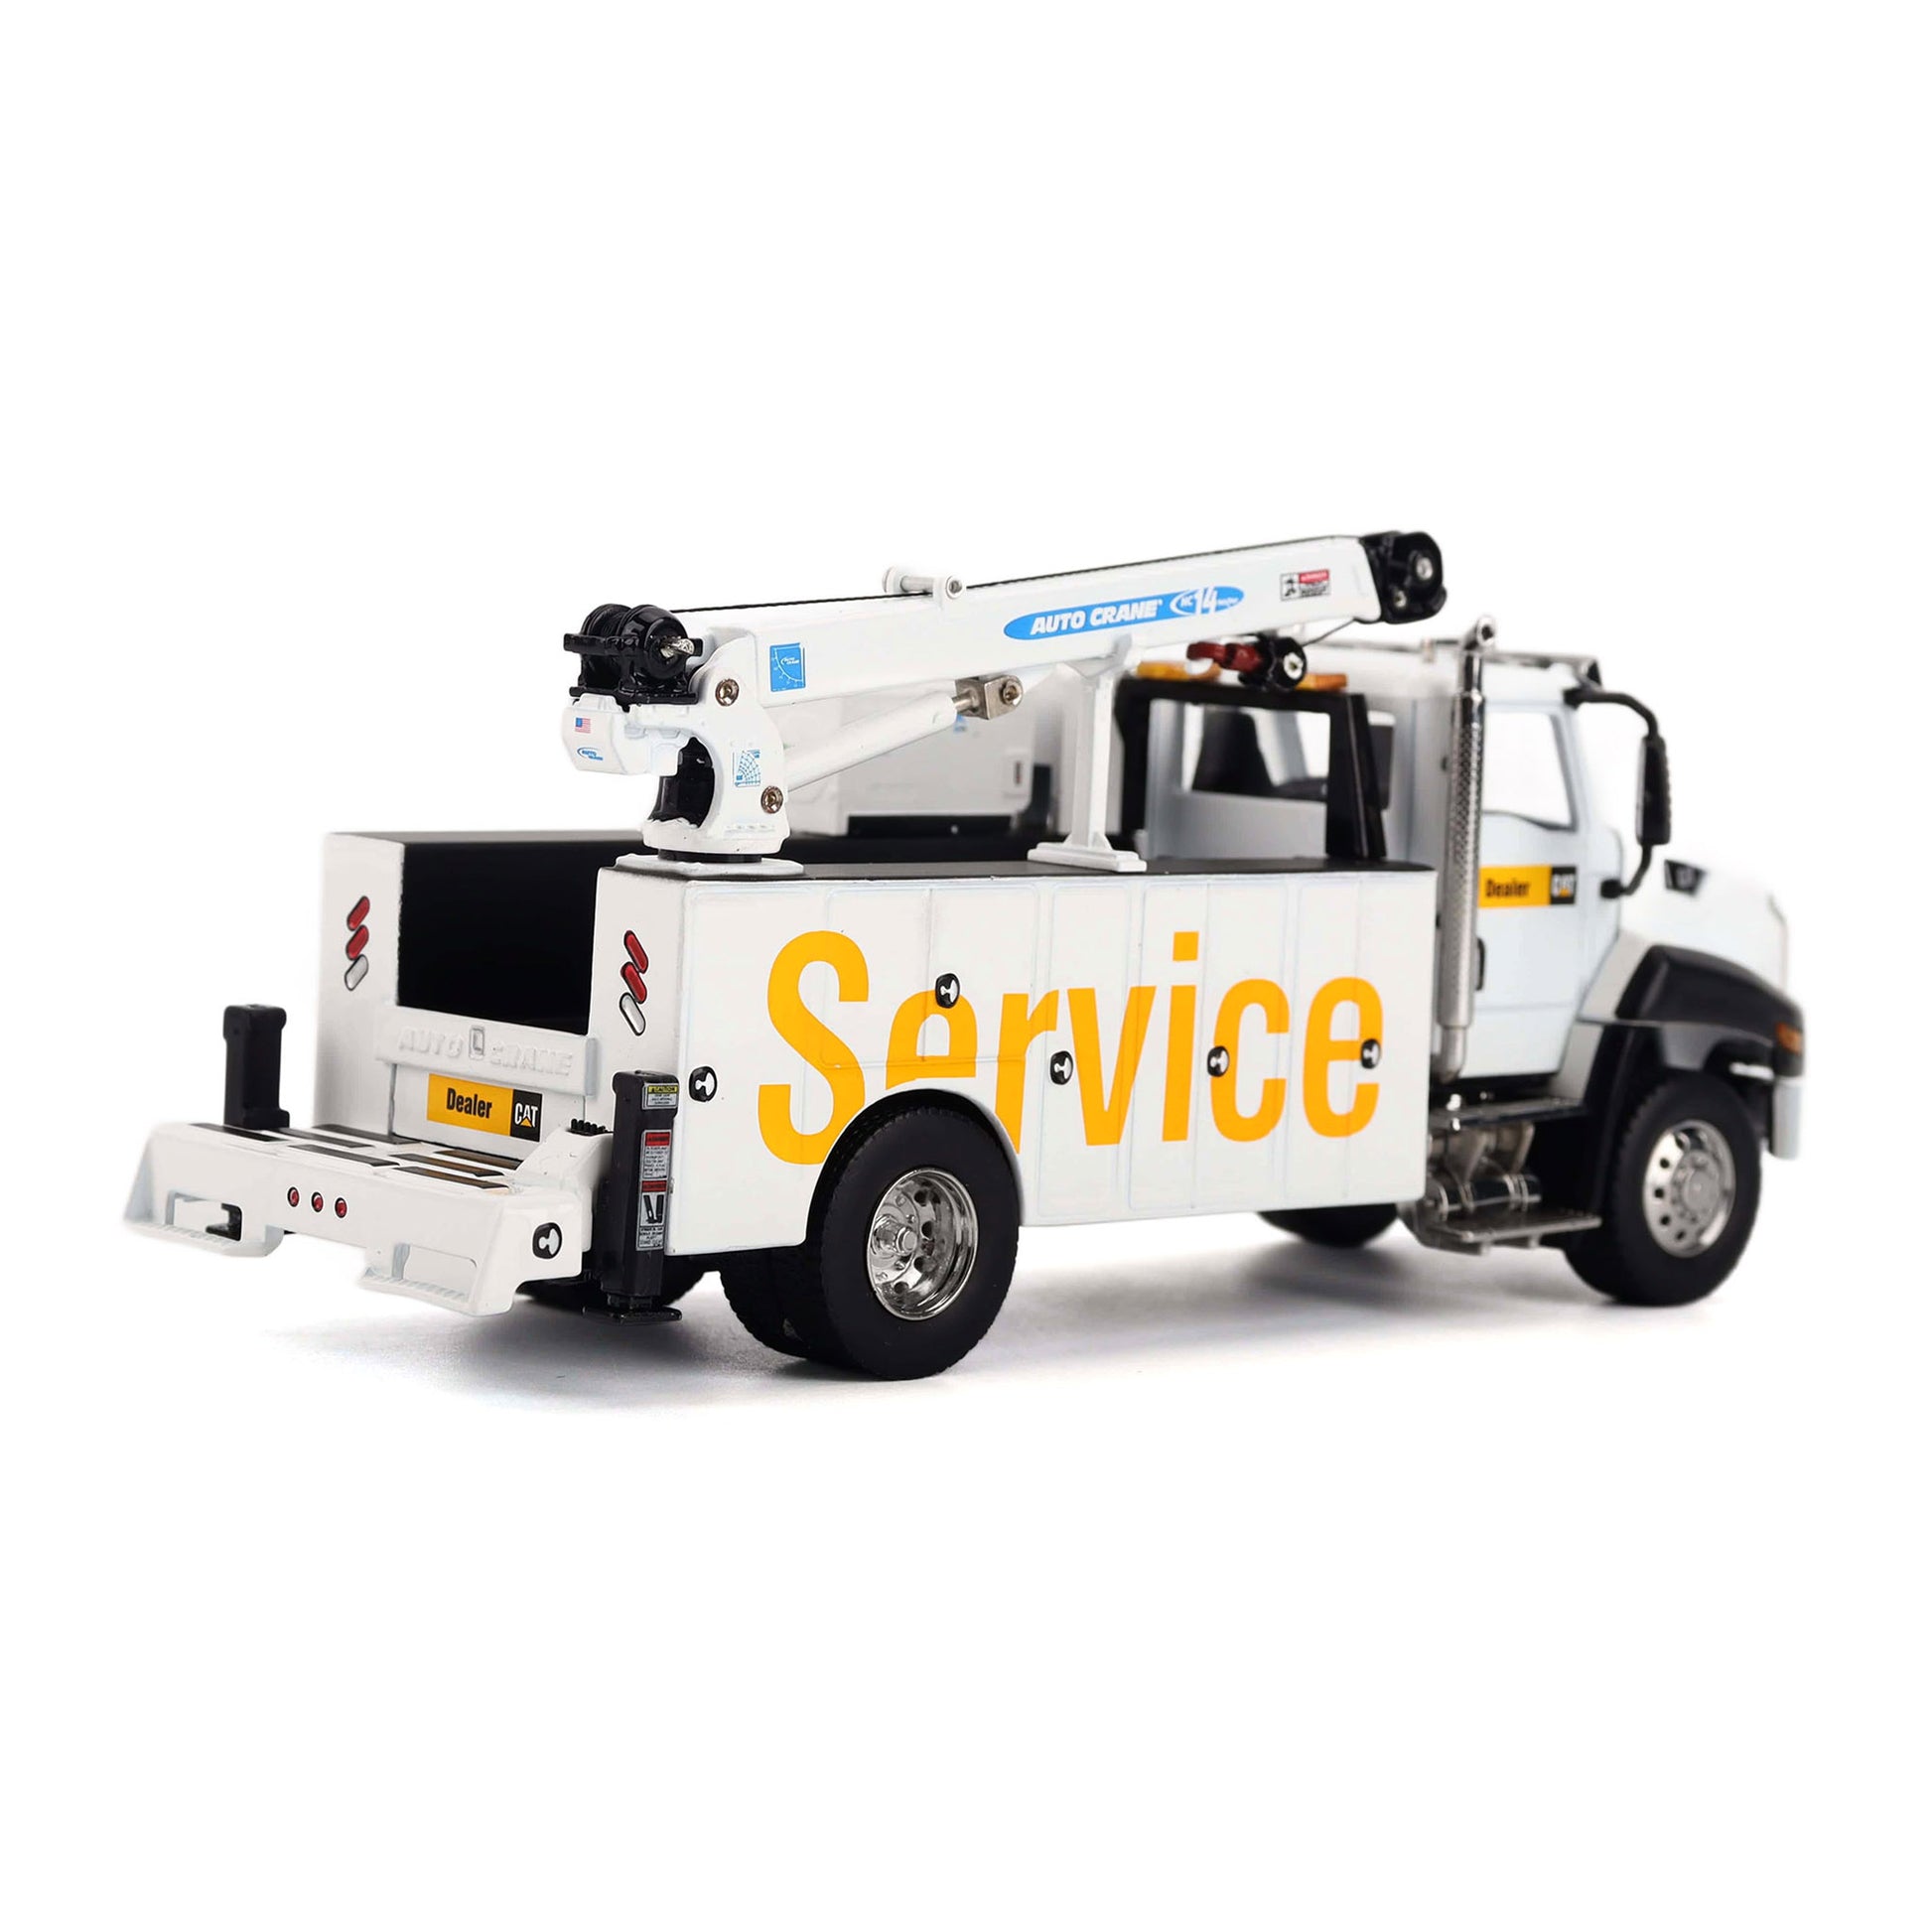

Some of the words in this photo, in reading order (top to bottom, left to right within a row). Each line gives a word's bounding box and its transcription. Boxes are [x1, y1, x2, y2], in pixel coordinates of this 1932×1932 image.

[1030, 610, 1086, 635] AUTO
[1089, 599, 1159, 626] CRANE
[1193, 586, 1219, 616] 14
[1485, 878, 1530, 898] Dealer
[398, 1026, 464, 1059] AUTO
[758, 930, 1384, 1165] Service
[446, 1087, 492, 1119] Dealer
[514, 1102, 538, 1128] CAT
